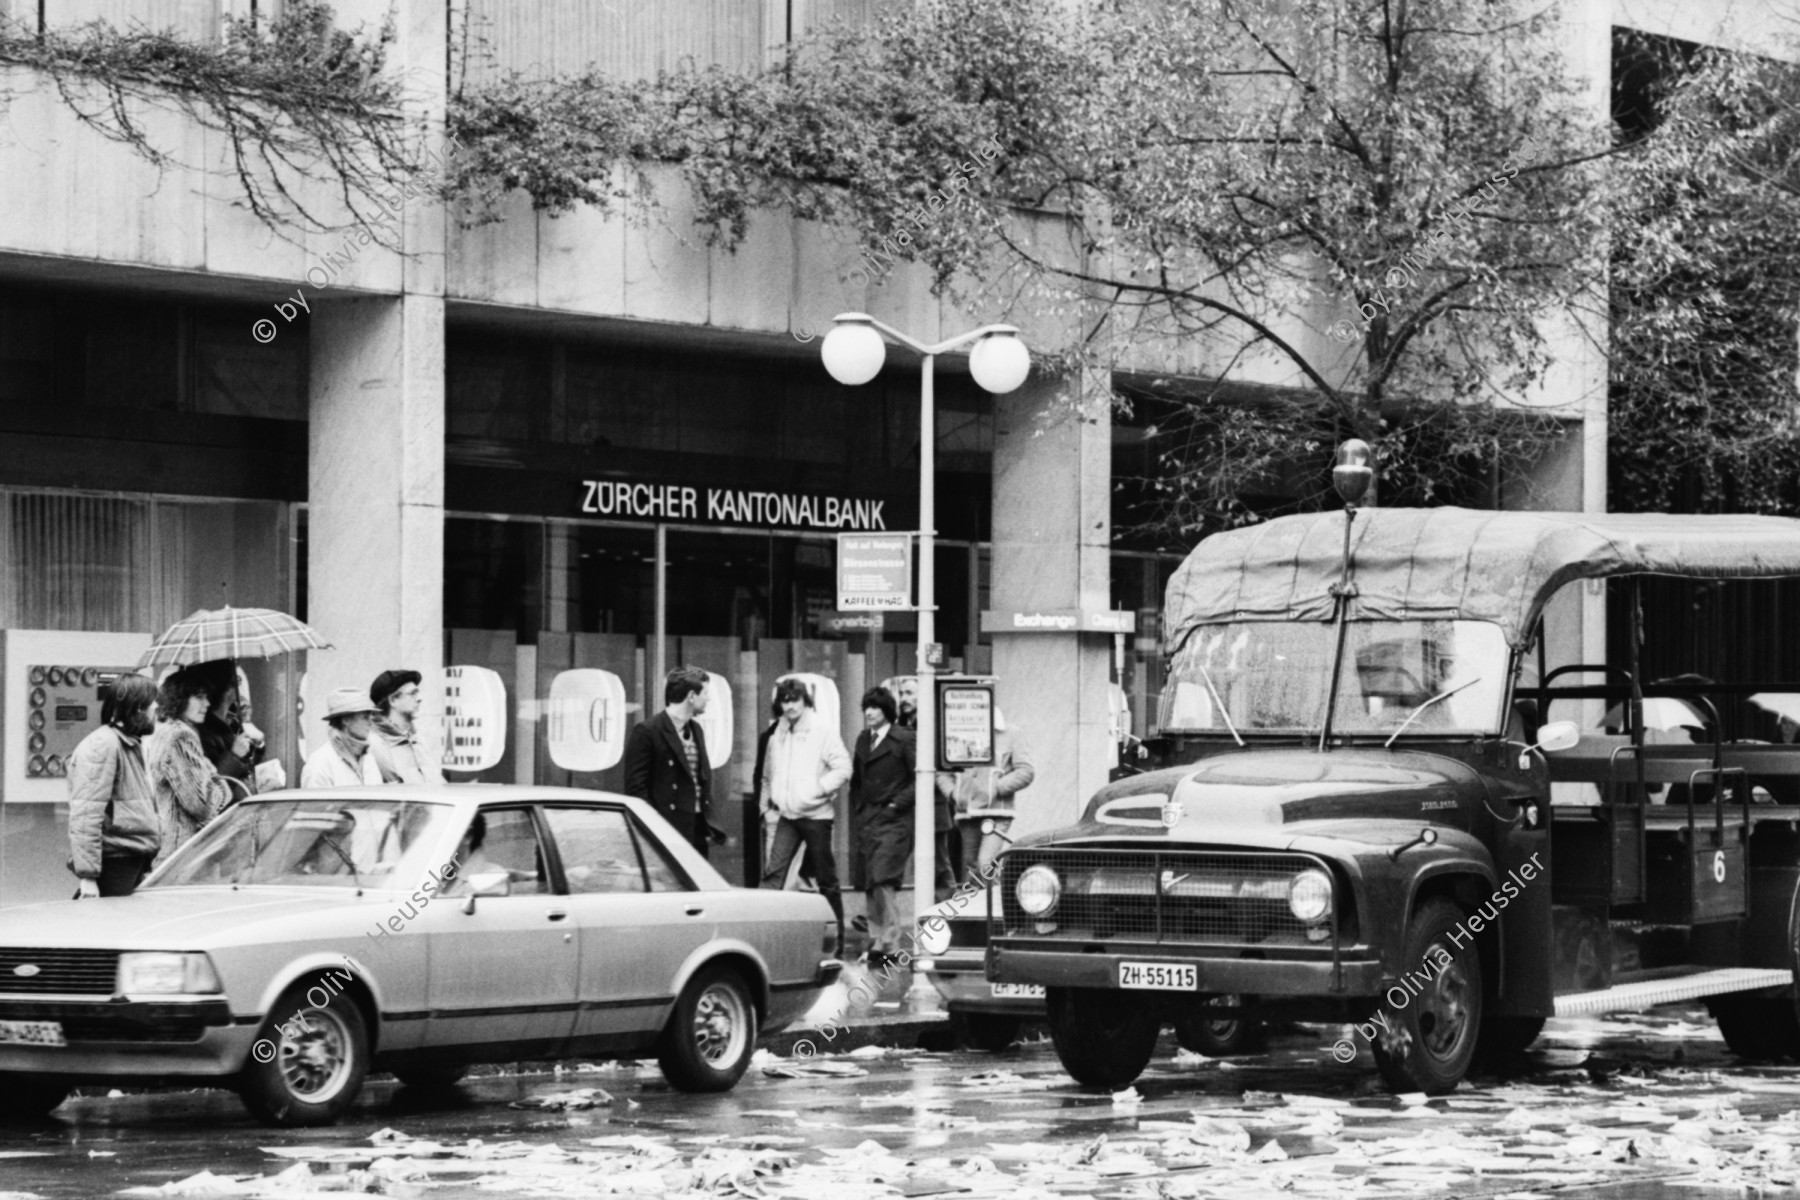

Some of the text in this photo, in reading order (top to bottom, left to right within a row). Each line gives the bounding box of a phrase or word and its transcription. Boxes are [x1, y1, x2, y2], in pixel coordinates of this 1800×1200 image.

[582, 480, 886, 530] ZÜRCHER KANTONALBANK
[845, 597, 876, 606] KAFFEE
[1714, 850, 1726, 883] 6
